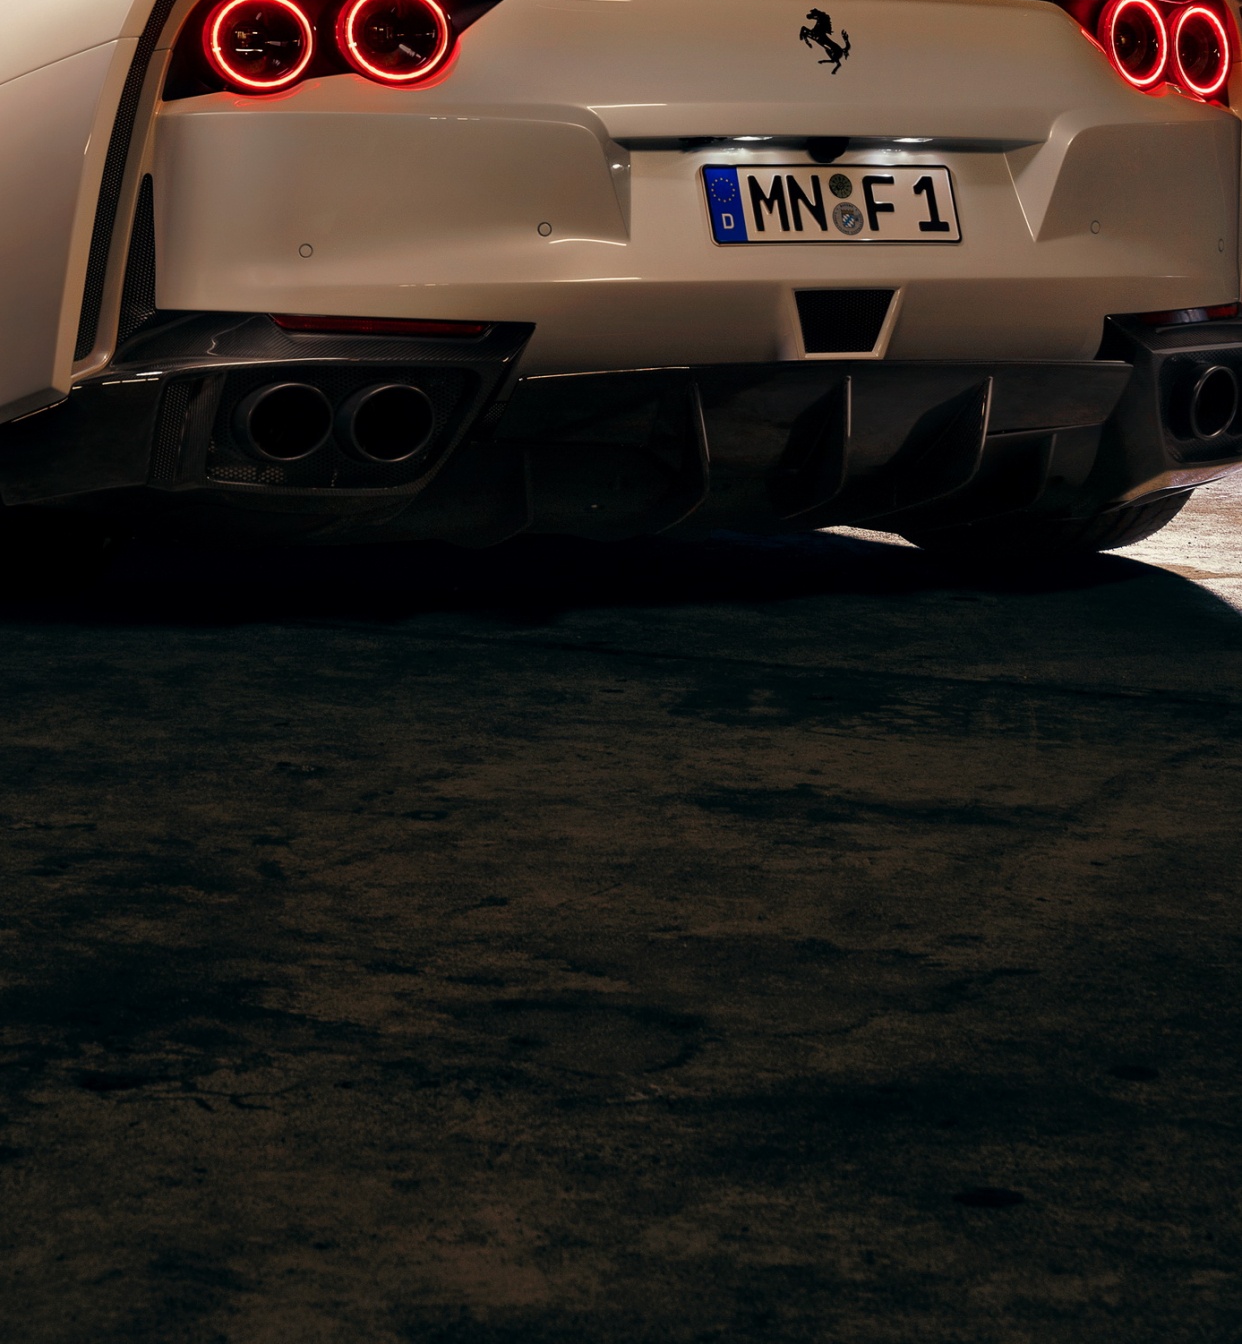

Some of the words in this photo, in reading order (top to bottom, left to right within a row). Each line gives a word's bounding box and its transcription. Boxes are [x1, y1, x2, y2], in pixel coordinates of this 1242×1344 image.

[722, 213, 735, 229] D
[747, 175, 828, 232] MN
[862, 175, 895, 231] F
[913, 175, 950, 232] 1
